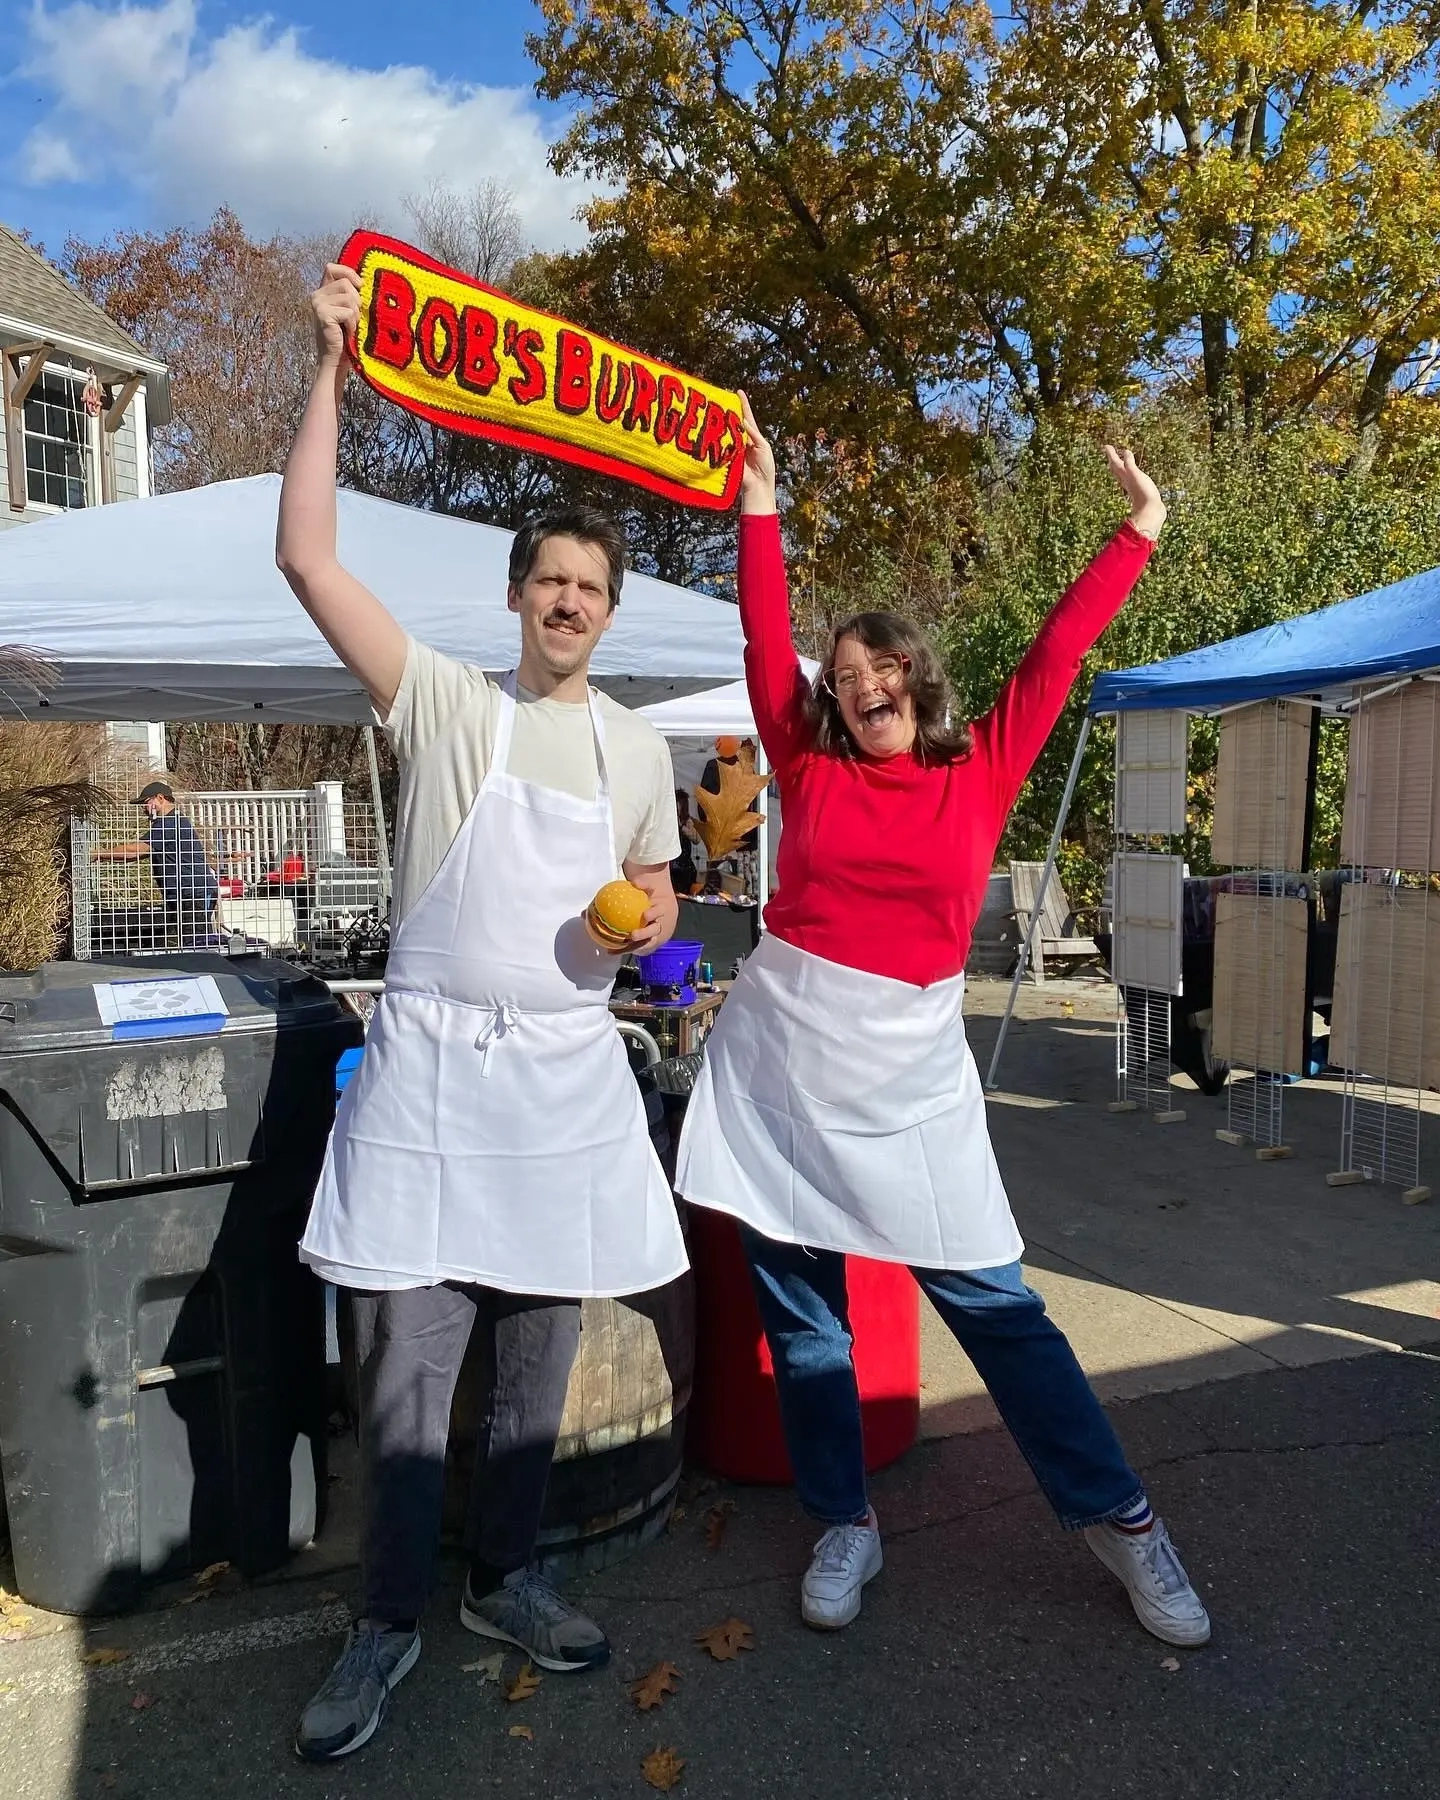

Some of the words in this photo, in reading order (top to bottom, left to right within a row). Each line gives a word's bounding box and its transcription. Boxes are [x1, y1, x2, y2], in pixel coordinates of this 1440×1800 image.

[364, 268, 547, 405] BOB'S
[554, 329, 744, 468] BURGERS
[126, 1007, 204, 1020] RECYCLE
